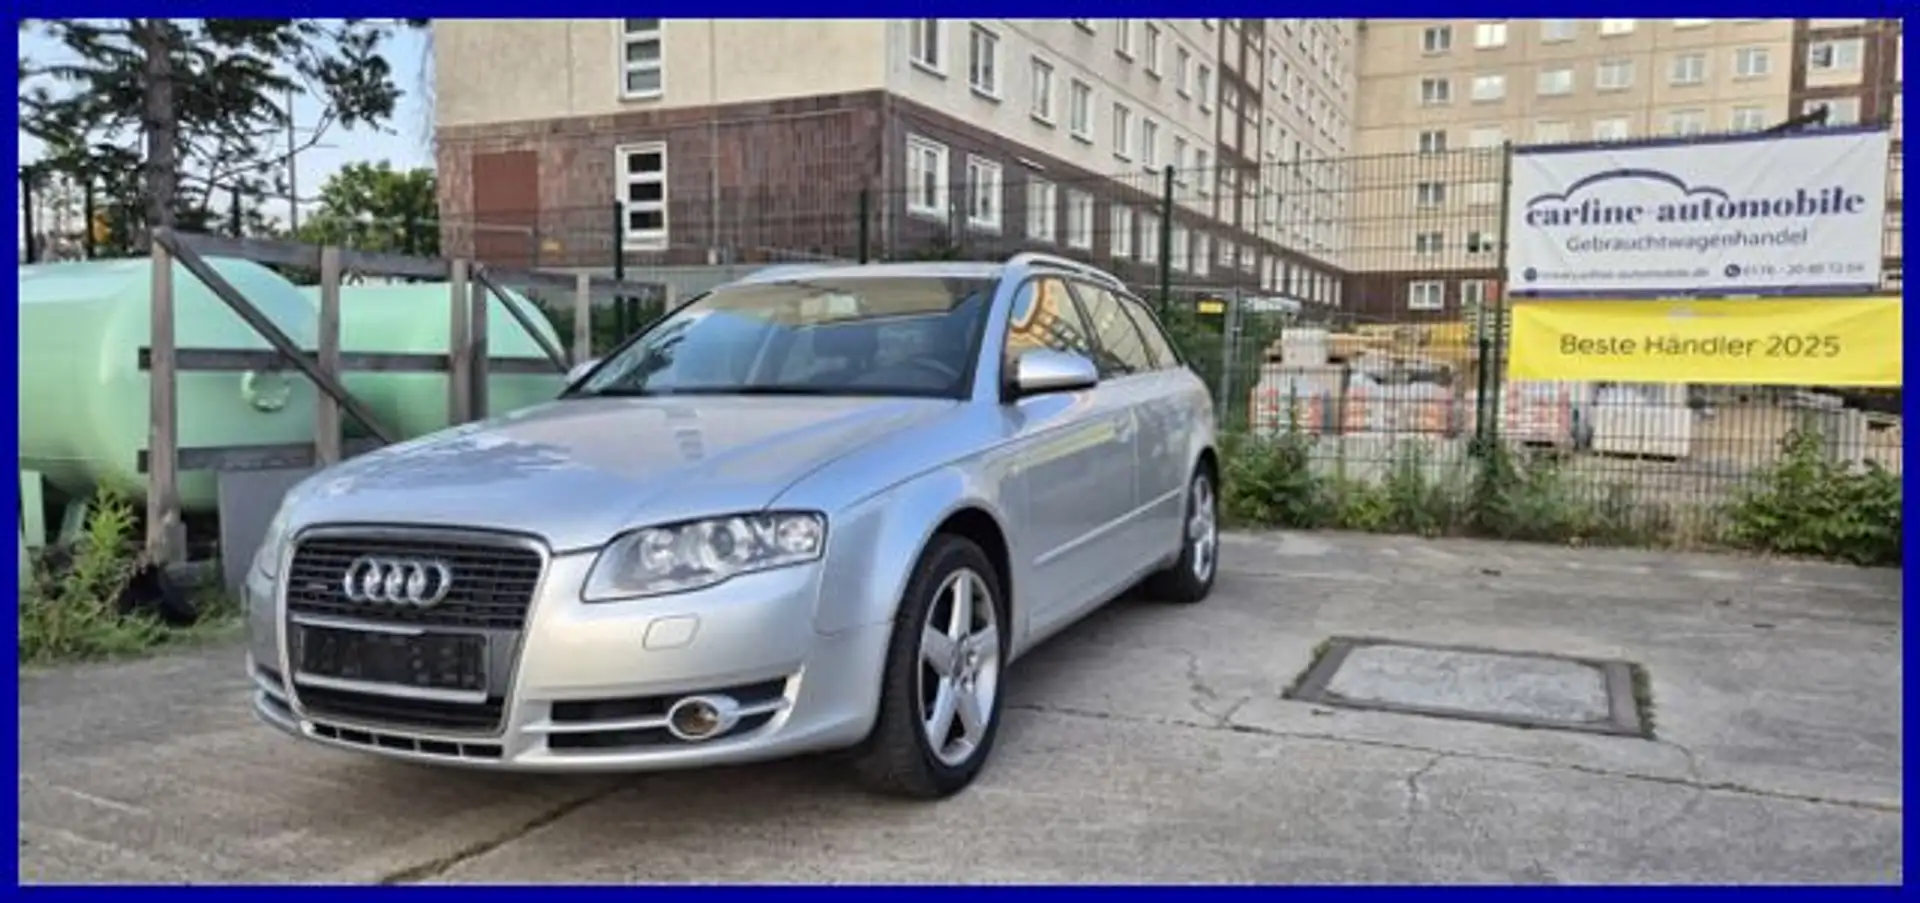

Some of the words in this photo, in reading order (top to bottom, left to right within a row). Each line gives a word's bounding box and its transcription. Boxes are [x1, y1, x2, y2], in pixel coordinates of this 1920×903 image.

[1566, 228, 1808, 253] Gebrauchtwagenhandel
[1560, 334, 1637, 355] Beste
[1644, 334, 1755, 357] Händler
[1764, 334, 1842, 357] 2025
